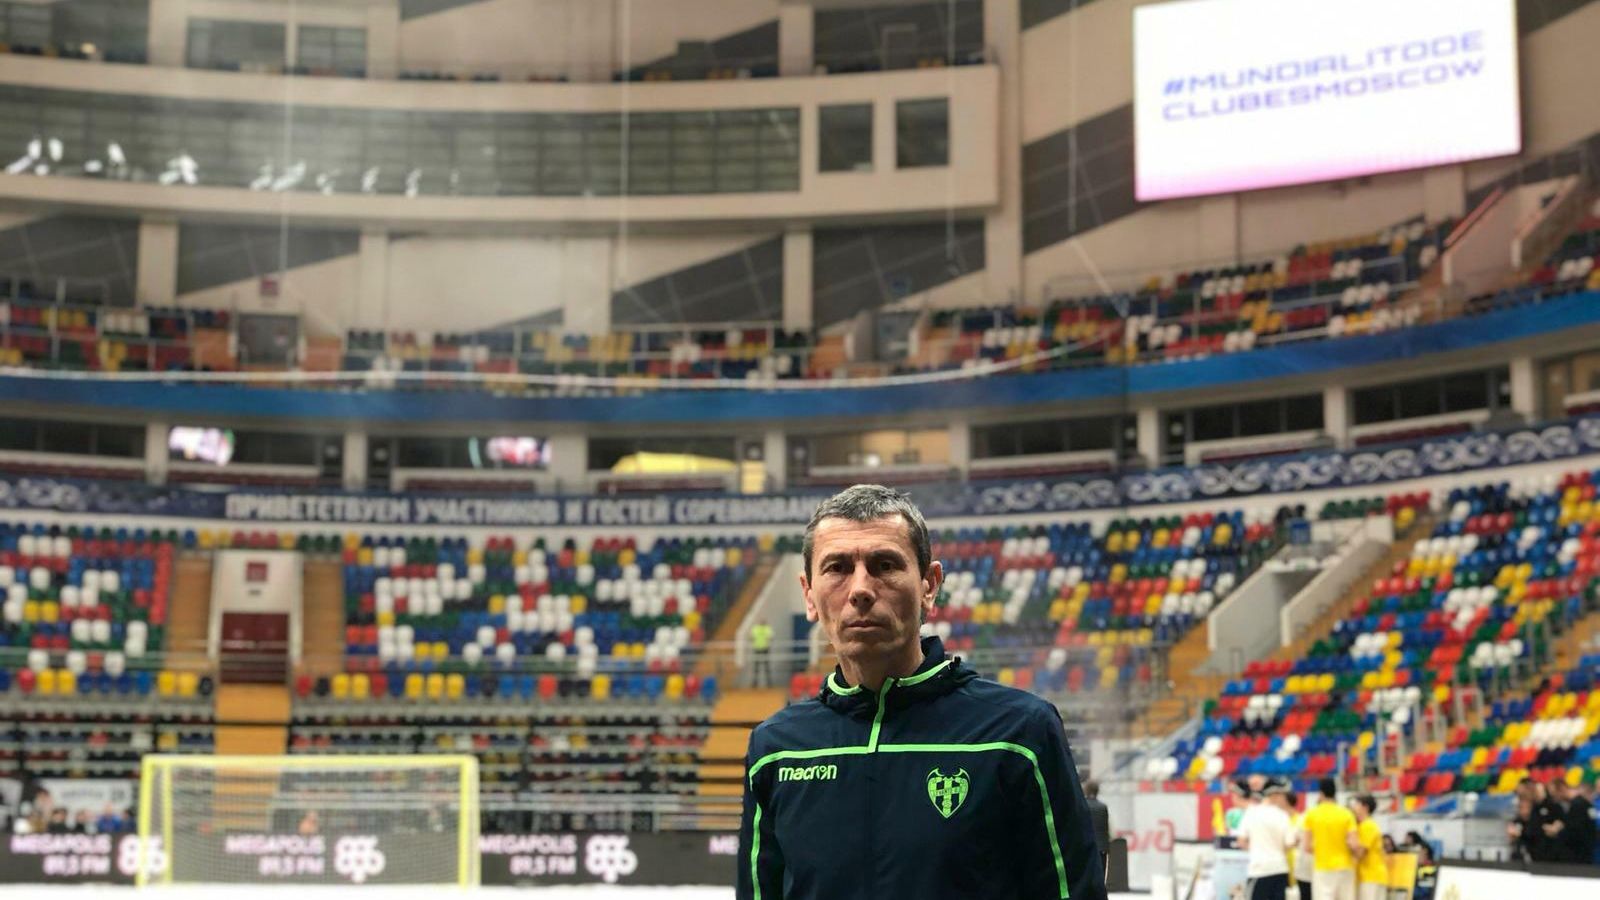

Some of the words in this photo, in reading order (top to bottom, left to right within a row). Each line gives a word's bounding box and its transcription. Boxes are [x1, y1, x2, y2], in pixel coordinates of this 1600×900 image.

[1163, 30, 1484, 95] #MUNDIALITODE
[1162, 59, 1485, 121] CLUBESMOSCOW
[225, 493, 410, 523] ПРИВЕТСТВУЕМ
[415, 497, 560, 524] УЧАСТНИКОВ
[564, 498, 583, 524] И
[587, 494, 671, 524] ГОСТЕЙ
[778, 764, 838, 782] macron
[10, 833, 112, 854] MEGAPOLIS
[225, 835, 326, 854] MEGAPOLIS
[479, 834, 578, 854] MEGAPOLIS
[81, 855, 111, 875] FM
[296, 856, 325, 875] FM
[547, 855, 577, 875] FM
